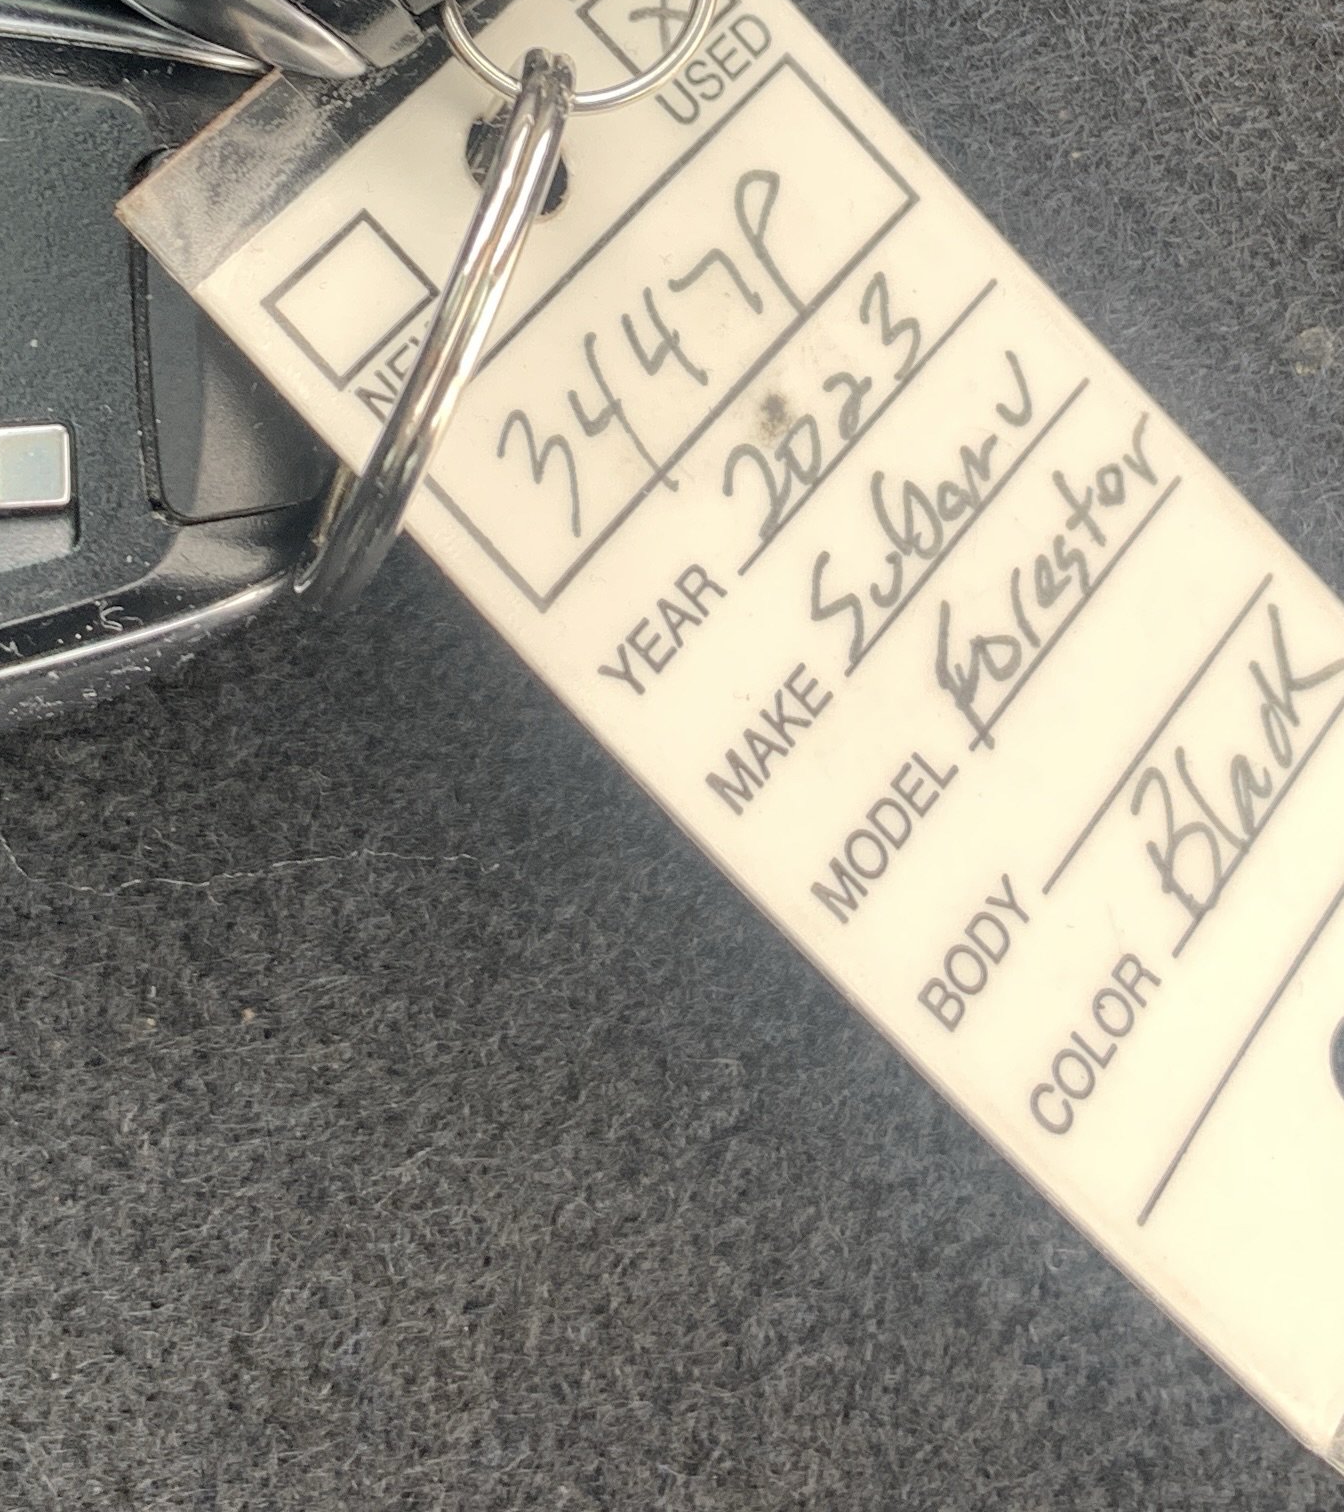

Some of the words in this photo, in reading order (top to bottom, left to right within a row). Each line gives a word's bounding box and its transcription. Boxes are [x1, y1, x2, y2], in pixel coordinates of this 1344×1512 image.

[656, 13, 772, 125] USED
[354, 320, 432, 426] NE
[496, 169, 808, 537] 3447P
[722, 271, 921, 539] 2023
[598, 563, 727, 695] YEAR
[704, 662, 834, 816] MAKE
[810, 752, 959, 925] MODEL
[917, 873, 1030, 1033] BODY
[1029, 952, 1162, 1135] COLOR
